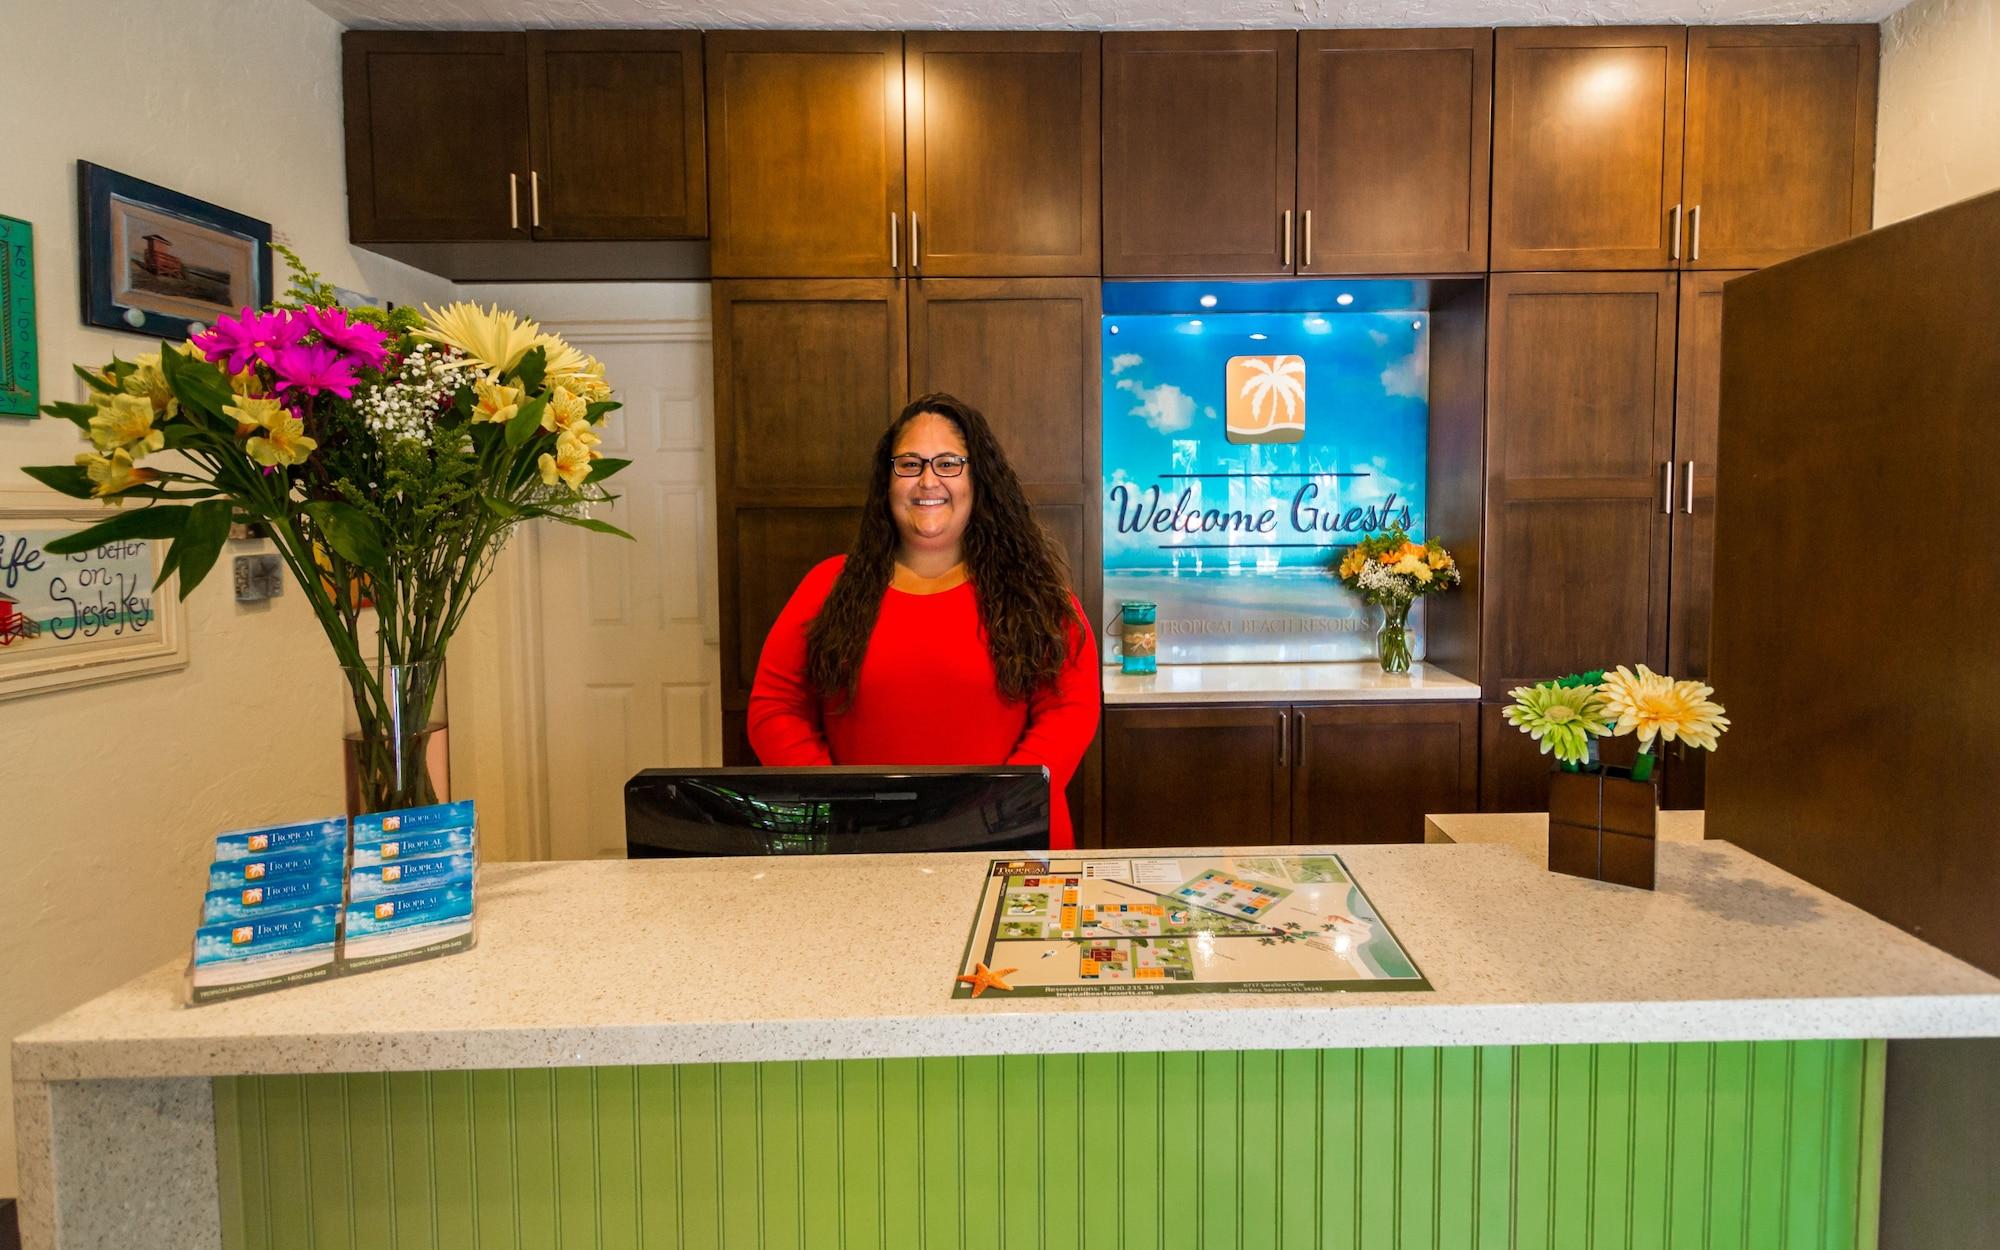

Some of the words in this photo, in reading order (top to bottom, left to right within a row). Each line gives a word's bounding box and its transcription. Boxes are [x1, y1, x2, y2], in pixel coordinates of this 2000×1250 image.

[1110, 483, 1278, 534] Welcome
[1290, 482, 1417, 533] Guests
[0, 534, 45, 588] ife
[79, 567, 112, 587] on
[50, 577, 117, 640] Siesta
[115, 573, 150, 636] Key
[1159, 619, 1234, 634] TROPICAL
[1242, 618, 1293, 633] BEACH
[1299, 616, 1370, 633] RESORTS
